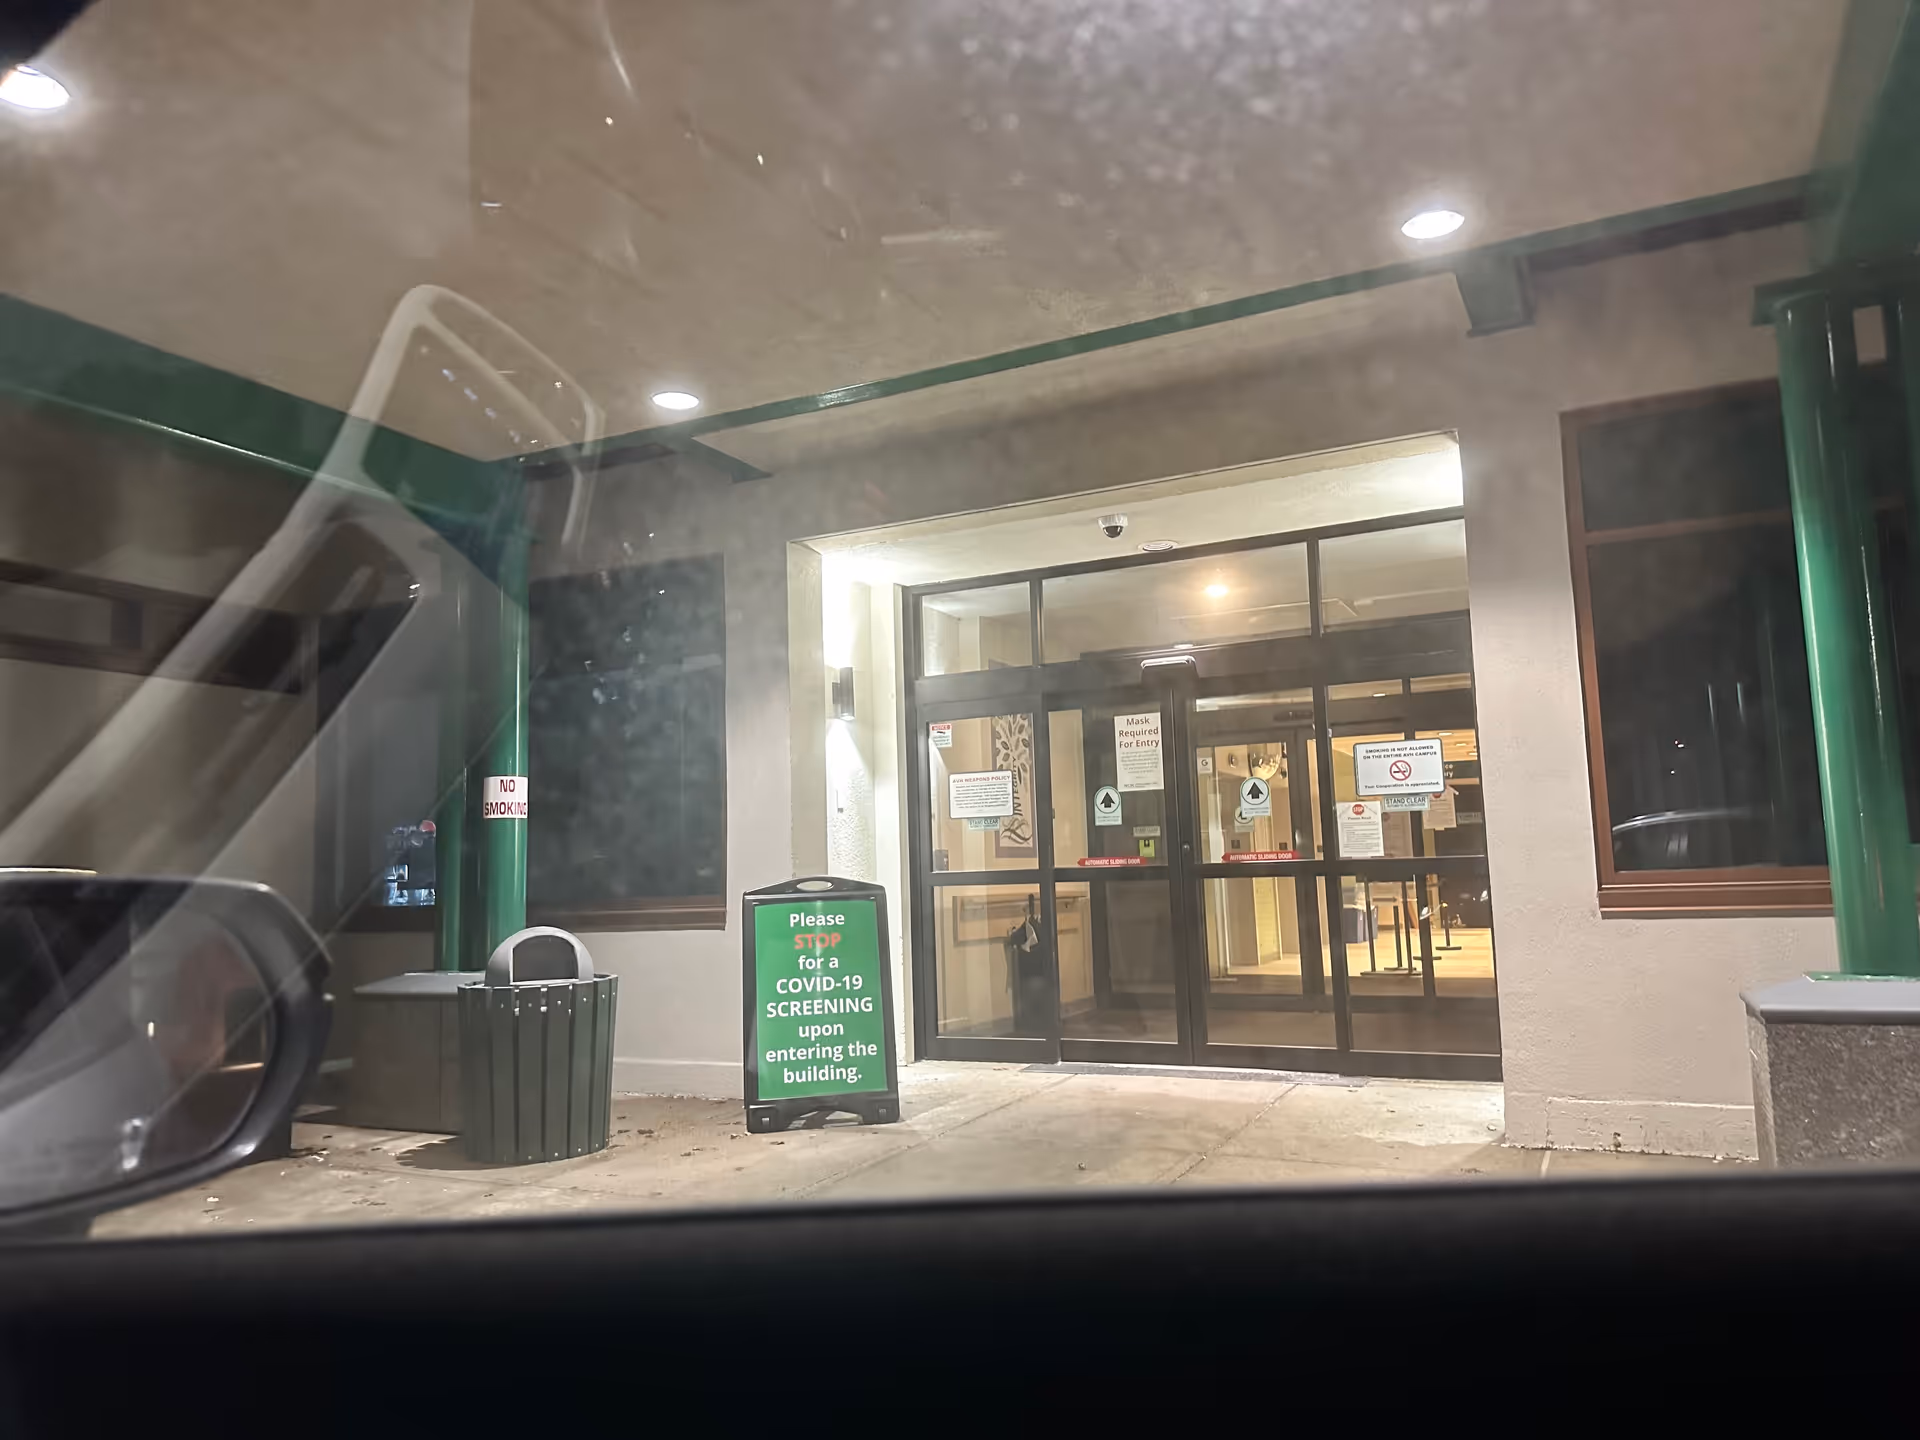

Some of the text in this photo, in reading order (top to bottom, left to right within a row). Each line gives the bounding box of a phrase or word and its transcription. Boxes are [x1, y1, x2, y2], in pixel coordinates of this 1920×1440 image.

[1126, 716, 1150, 726] Mask
[1119, 727, 1159, 738] Required
[1135, 739, 1160, 748] Entry
[500, 779, 515, 793] NO
[1012, 756, 1023, 816] INTEGRITY
[789, 912, 845, 927] Please
[794, 932, 841, 949] STOP
[798, 955, 839, 970] for a
[776, 975, 863, 994] COVID-19
[766, 997, 873, 1018] SCREENING
[799, 1023, 844, 1041] upon
[765, 1041, 878, 1062] entering the
[783, 1065, 862, 1083] building.
